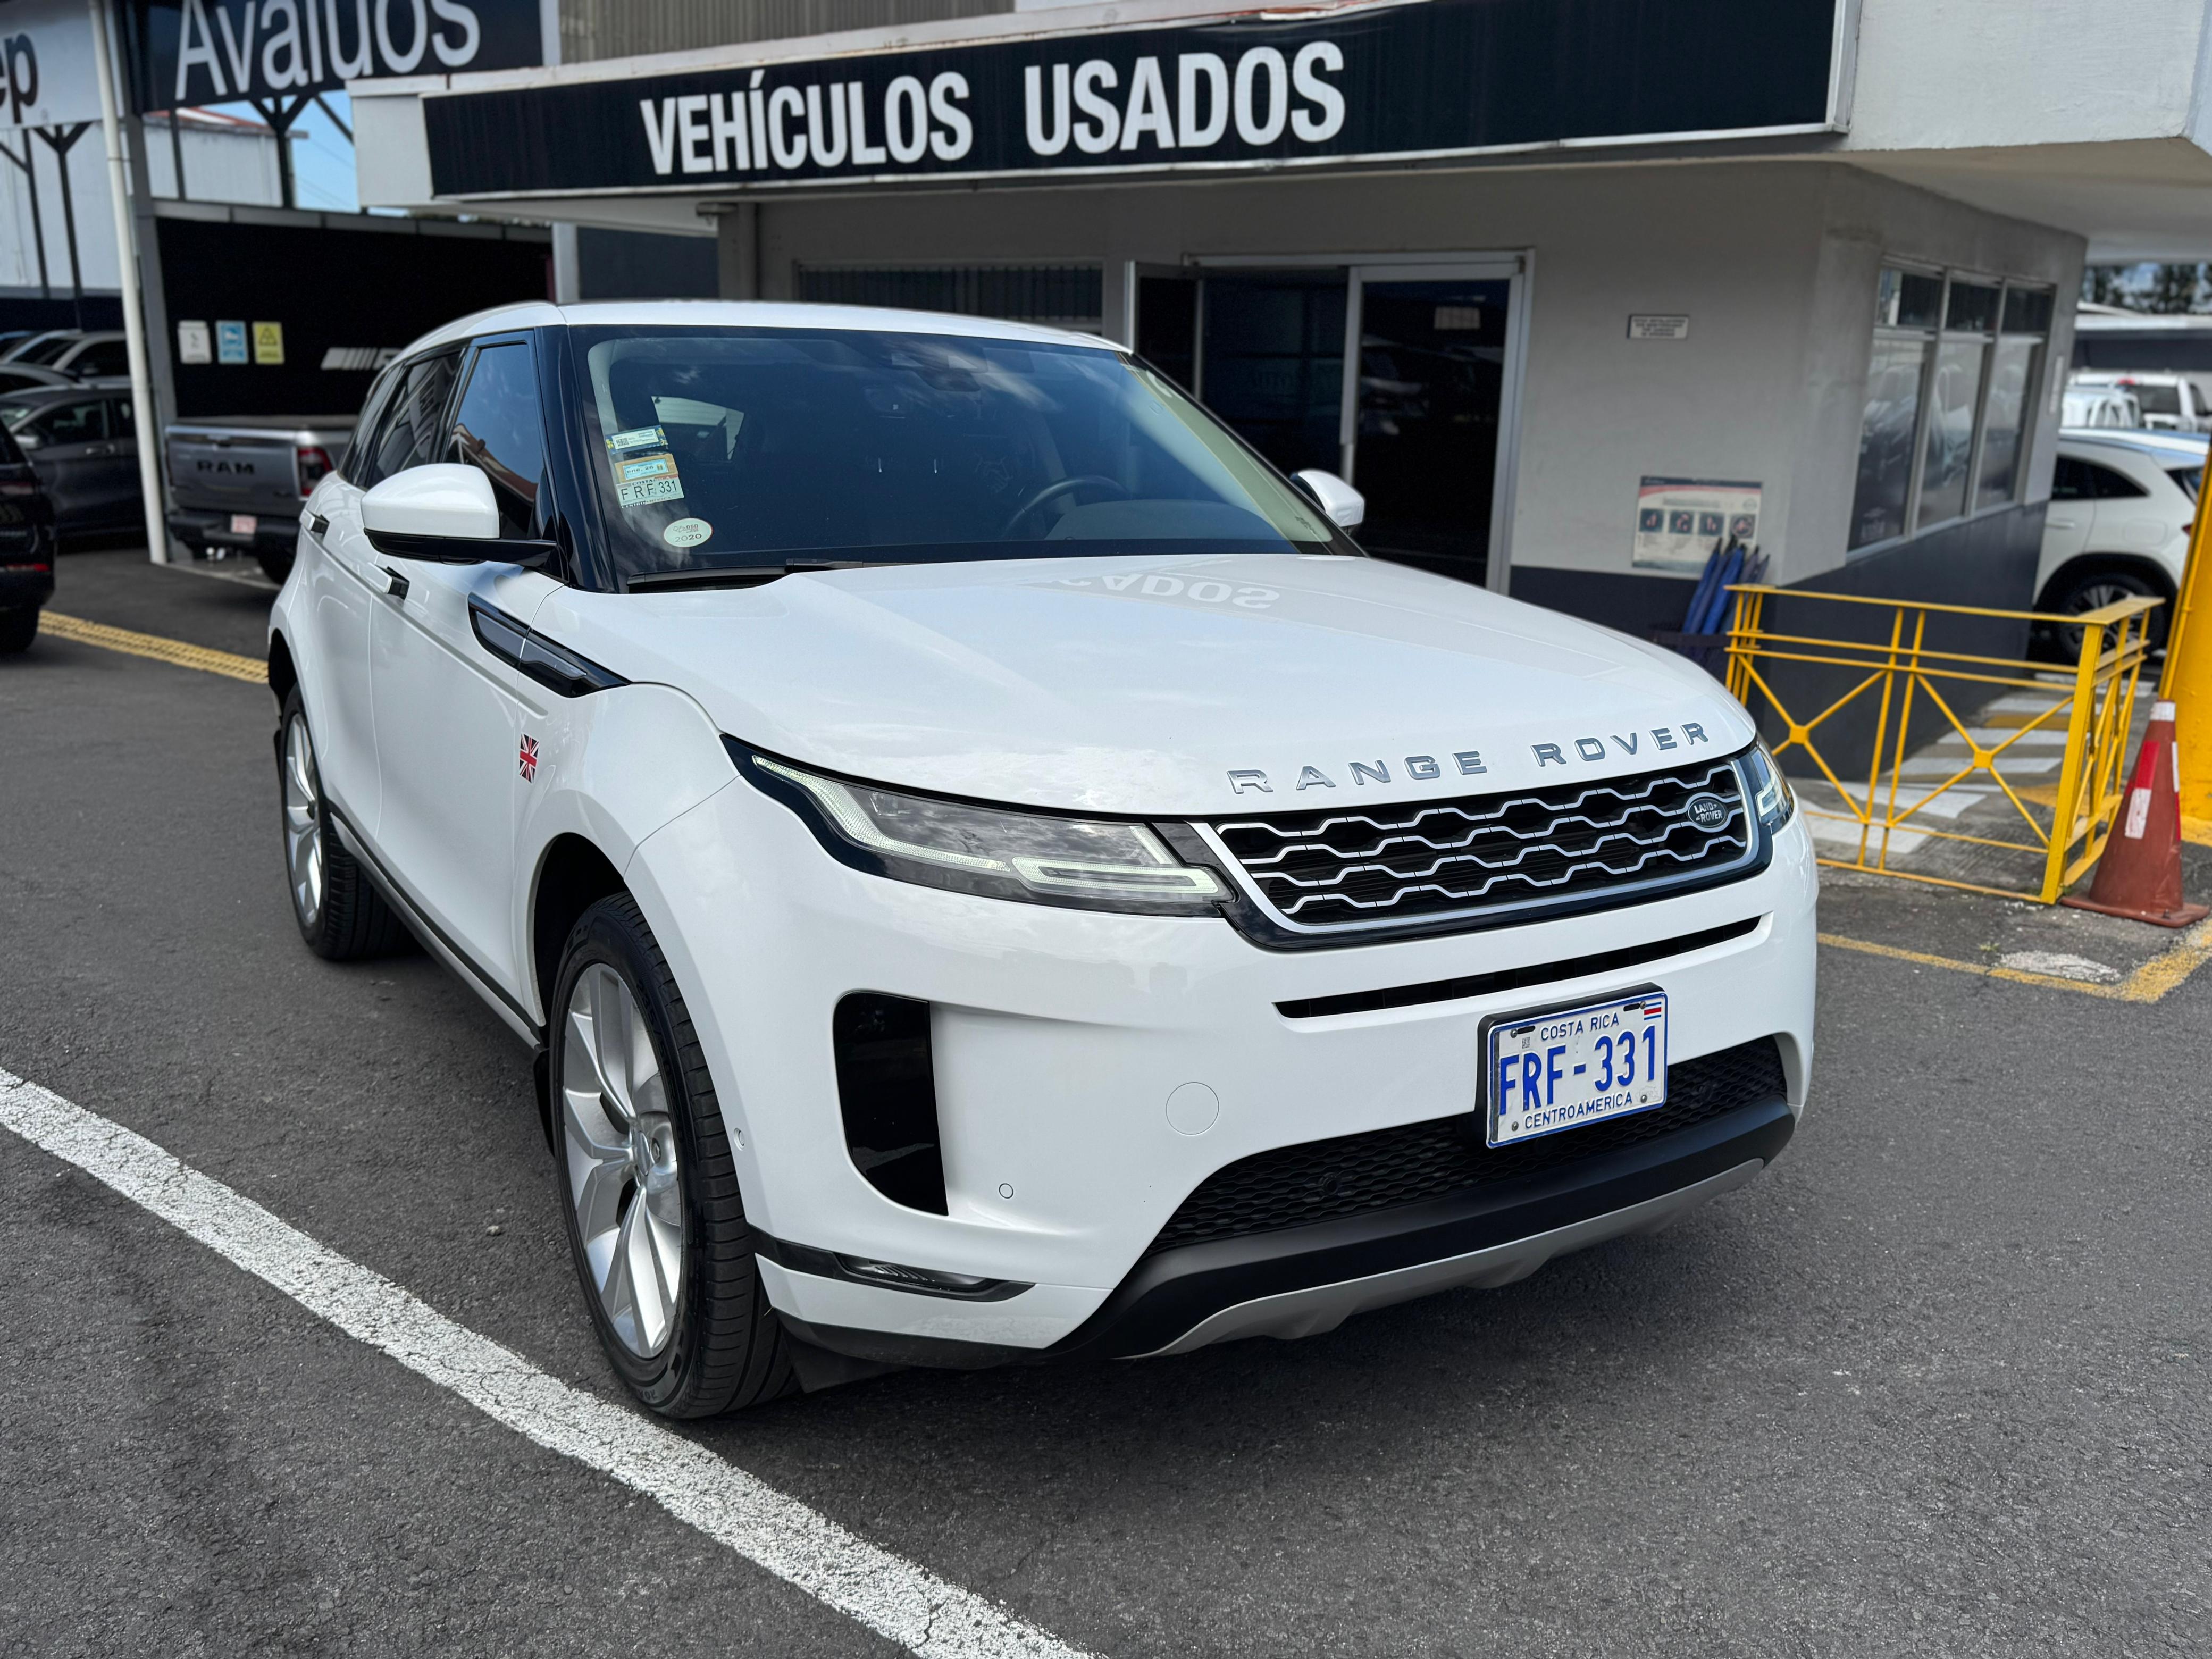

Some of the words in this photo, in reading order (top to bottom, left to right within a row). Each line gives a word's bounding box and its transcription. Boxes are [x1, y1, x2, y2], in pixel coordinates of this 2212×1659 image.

[0, 33, 38, 124] p
[640, 69, 974, 175] VEHÍCULOS
[1024, 41, 1346, 157] USADOS
[197, 460, 255, 475] RAM
[658, 480, 677, 493] 331
[675, 533, 702, 543] 2020
[1226, 750, 1488, 795] RANGE
[1530, 722, 1709, 767] ROVER
[1694, 802, 1714, 814] LAND
[1700, 810, 1722, 823] ROVER
[1541, 1020, 1583, 1041] COSTA
[1590, 1012, 1619, 1032] RICA
[1499, 1025, 1656, 1116] FRF-331
[1524, 1091, 1632, 1129] CENTROAMERICA
